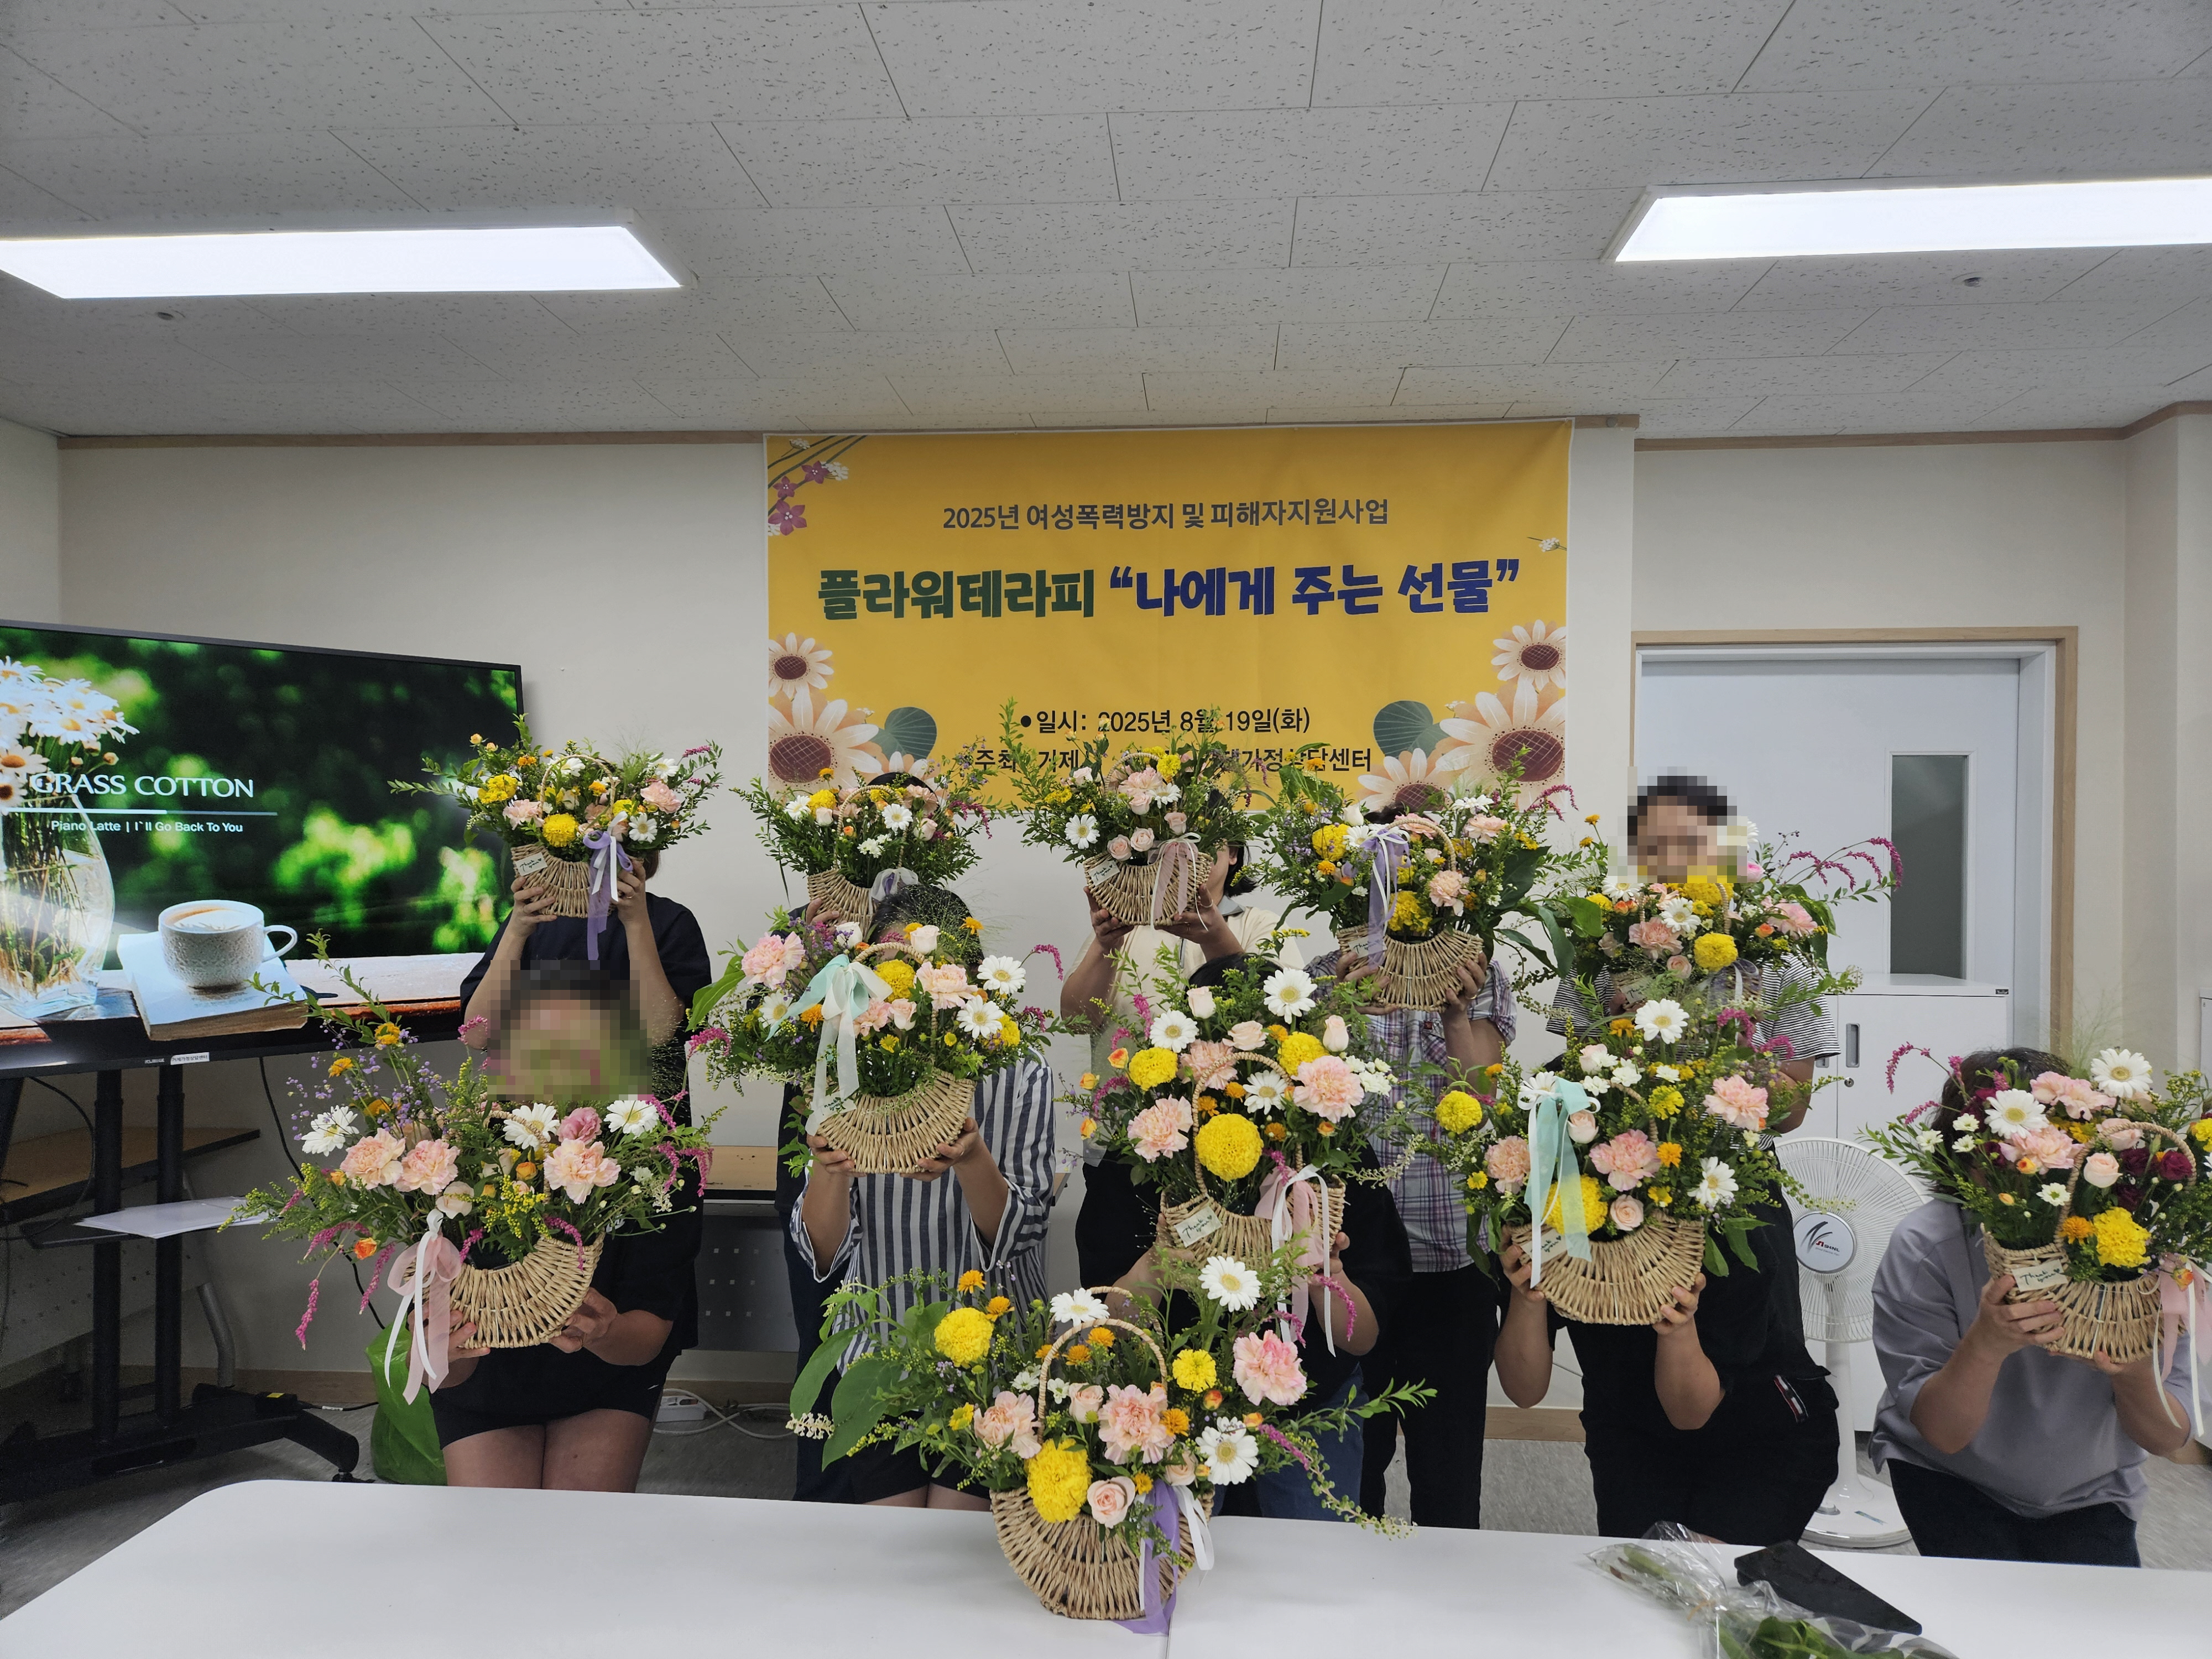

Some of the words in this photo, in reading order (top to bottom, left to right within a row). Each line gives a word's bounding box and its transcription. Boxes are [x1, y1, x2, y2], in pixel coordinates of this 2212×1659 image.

[943, 504, 1019, 530] 2025년
[1026, 502, 1173, 530] 여성폭력방지
[1182, 502, 1205, 529] 및
[1210, 498, 1388, 528] 피해자지원사업
[817, 569, 1094, 620] 플라워테라피
[1110, 565, 1275, 617] “나에게
[1292, 564, 1383, 615] 주는
[1397, 559, 1520, 614] 선물”
[1036, 710, 1087, 733] 일시:
[1180, 708, 1216, 733] 8월
[1225, 707, 1310, 734] 19일(화)
[30, 773, 127, 795] GRASS
[134, 776, 254, 798] COTTON
[51, 821, 86, 831] Piano
[90, 821, 121, 831] Latte
[155, 822, 174, 831] Go
[175, 822, 204, 832] Back
[206, 822, 220, 832] To
[222, 822, 243, 833] You
[1182, 1219, 1203, 1239] Thank
[2020, 1270, 2048, 1285] Thank
